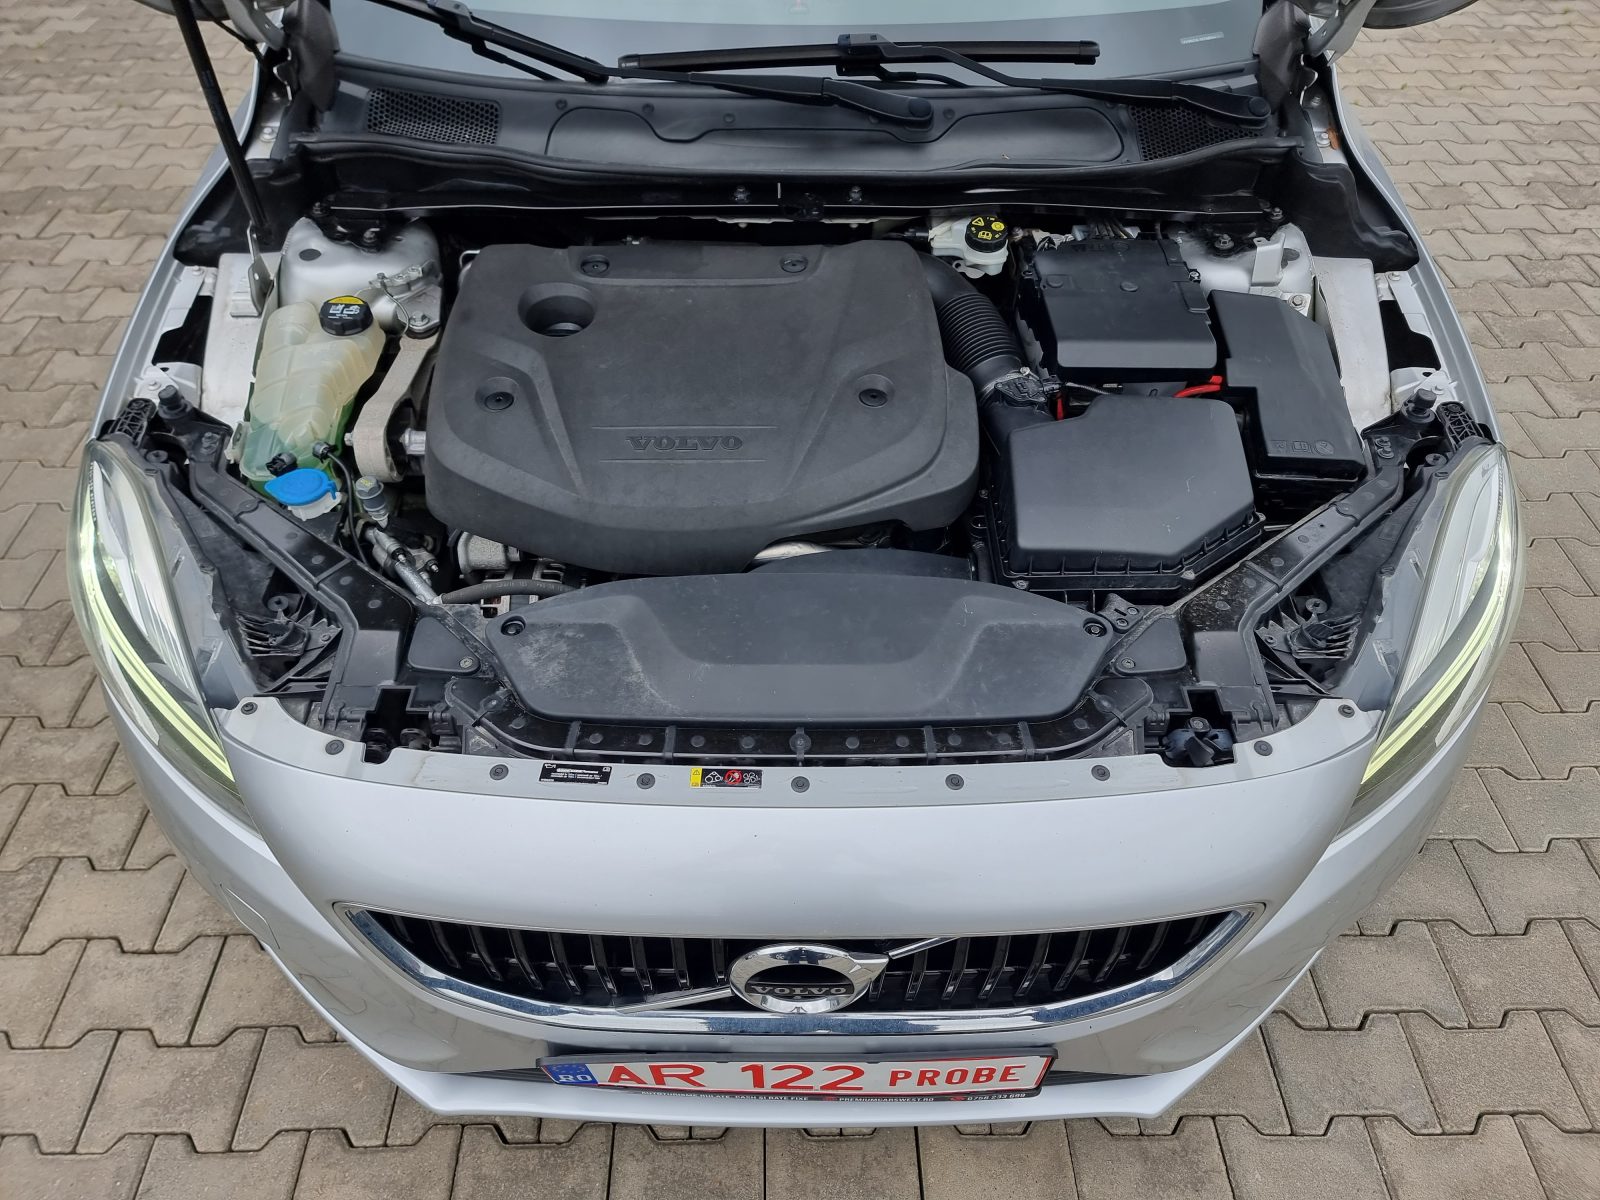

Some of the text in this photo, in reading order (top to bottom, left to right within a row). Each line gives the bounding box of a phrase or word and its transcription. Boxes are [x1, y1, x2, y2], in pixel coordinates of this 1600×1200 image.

[625, 436, 744, 451] VOLVO
[751, 985, 847, 995] VOLVO
[558, 1073, 593, 1083] RO
[608, 1064, 1026, 1091] AR 122 PROBE
